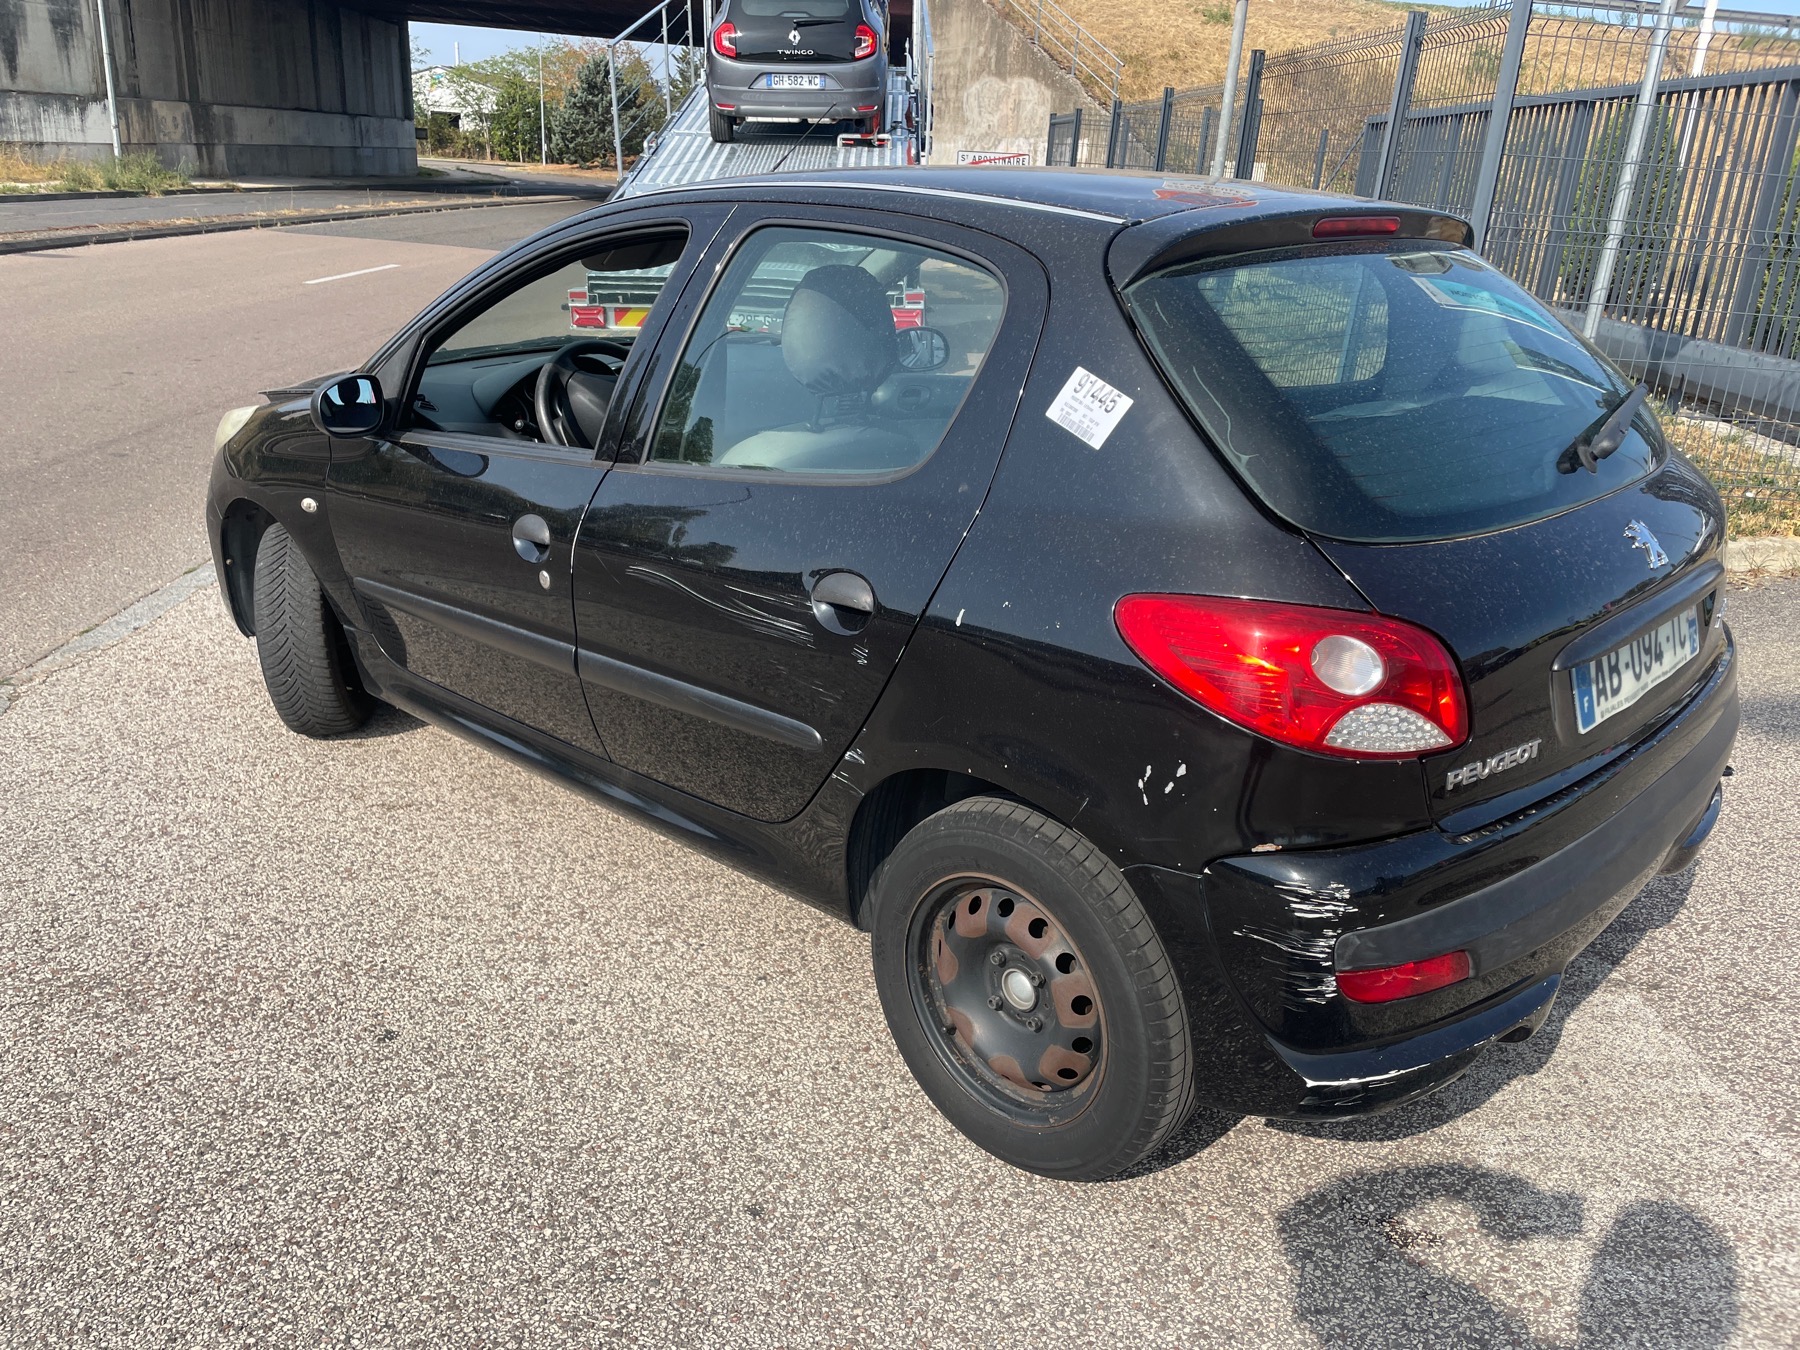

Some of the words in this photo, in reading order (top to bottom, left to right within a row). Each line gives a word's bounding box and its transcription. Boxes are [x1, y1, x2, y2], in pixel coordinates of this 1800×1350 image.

[773, 75, 819, 86] GH-582-WC
[972, 155, 1026, 166] APOLLINAIRE
[1073, 373, 1123, 414] 91445
[1583, 696, 1589, 713] F
[1446, 738, 1542, 791] PEUGEOT
